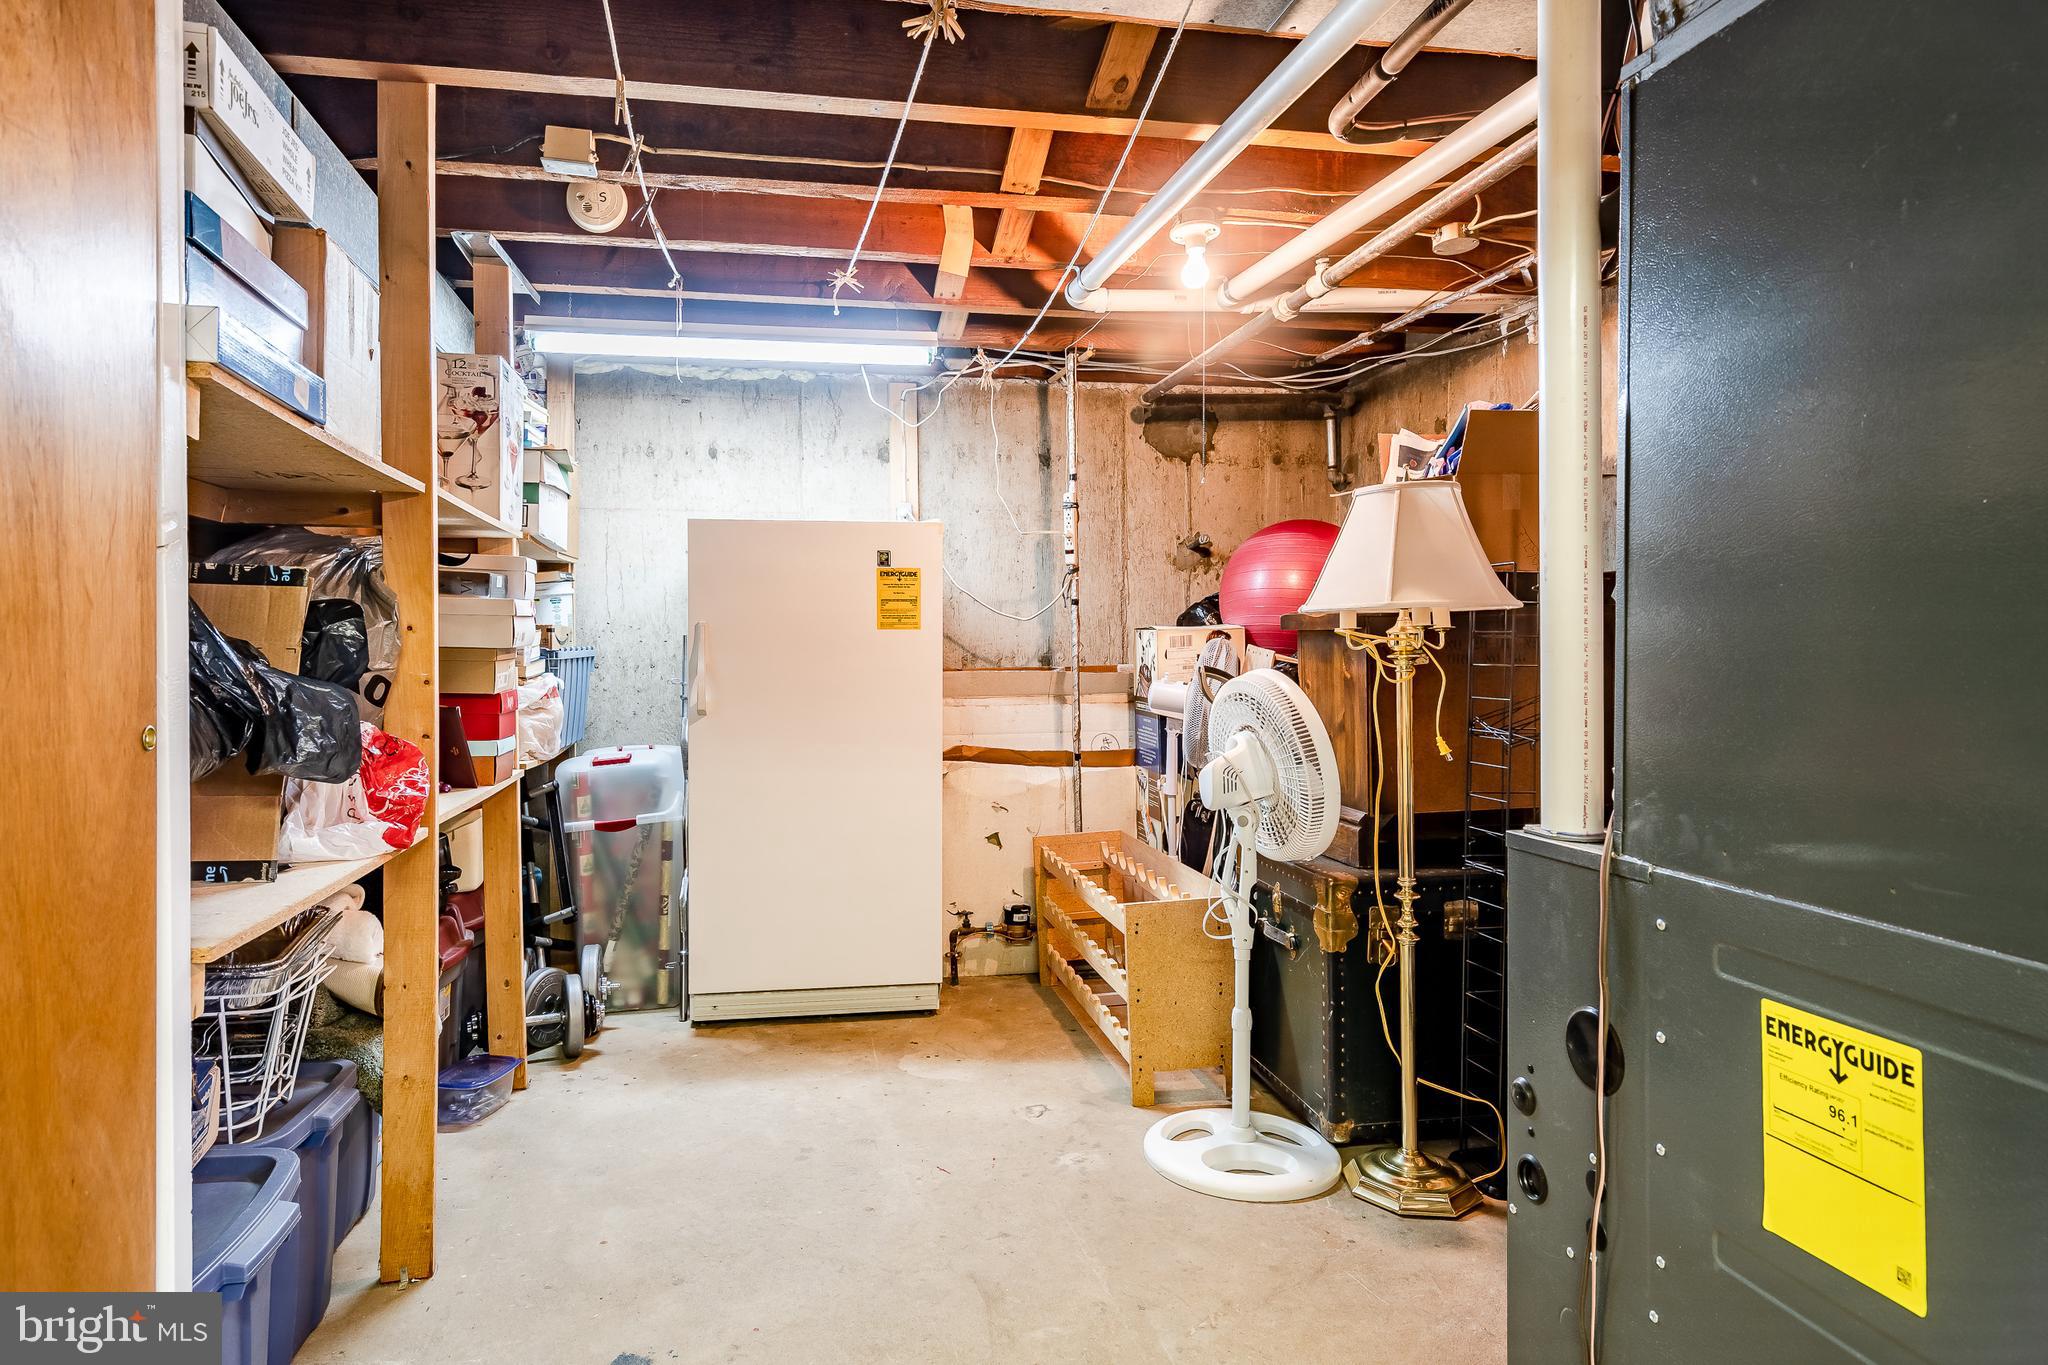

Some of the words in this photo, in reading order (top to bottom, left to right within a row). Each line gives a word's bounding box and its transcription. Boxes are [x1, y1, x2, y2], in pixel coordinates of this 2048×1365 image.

[190, 90, 207, 98] 215
[598, 190, 607, 203] S
[452, 359, 467, 369] 12
[1765, 1015, 1916, 1088] ENERGYGUIDE
[1779, 1072, 1808, 1092] Efficiency
[1808, 1084, 1829, 1101] Rating
[1828, 1104, 1858, 1128] 96.1
